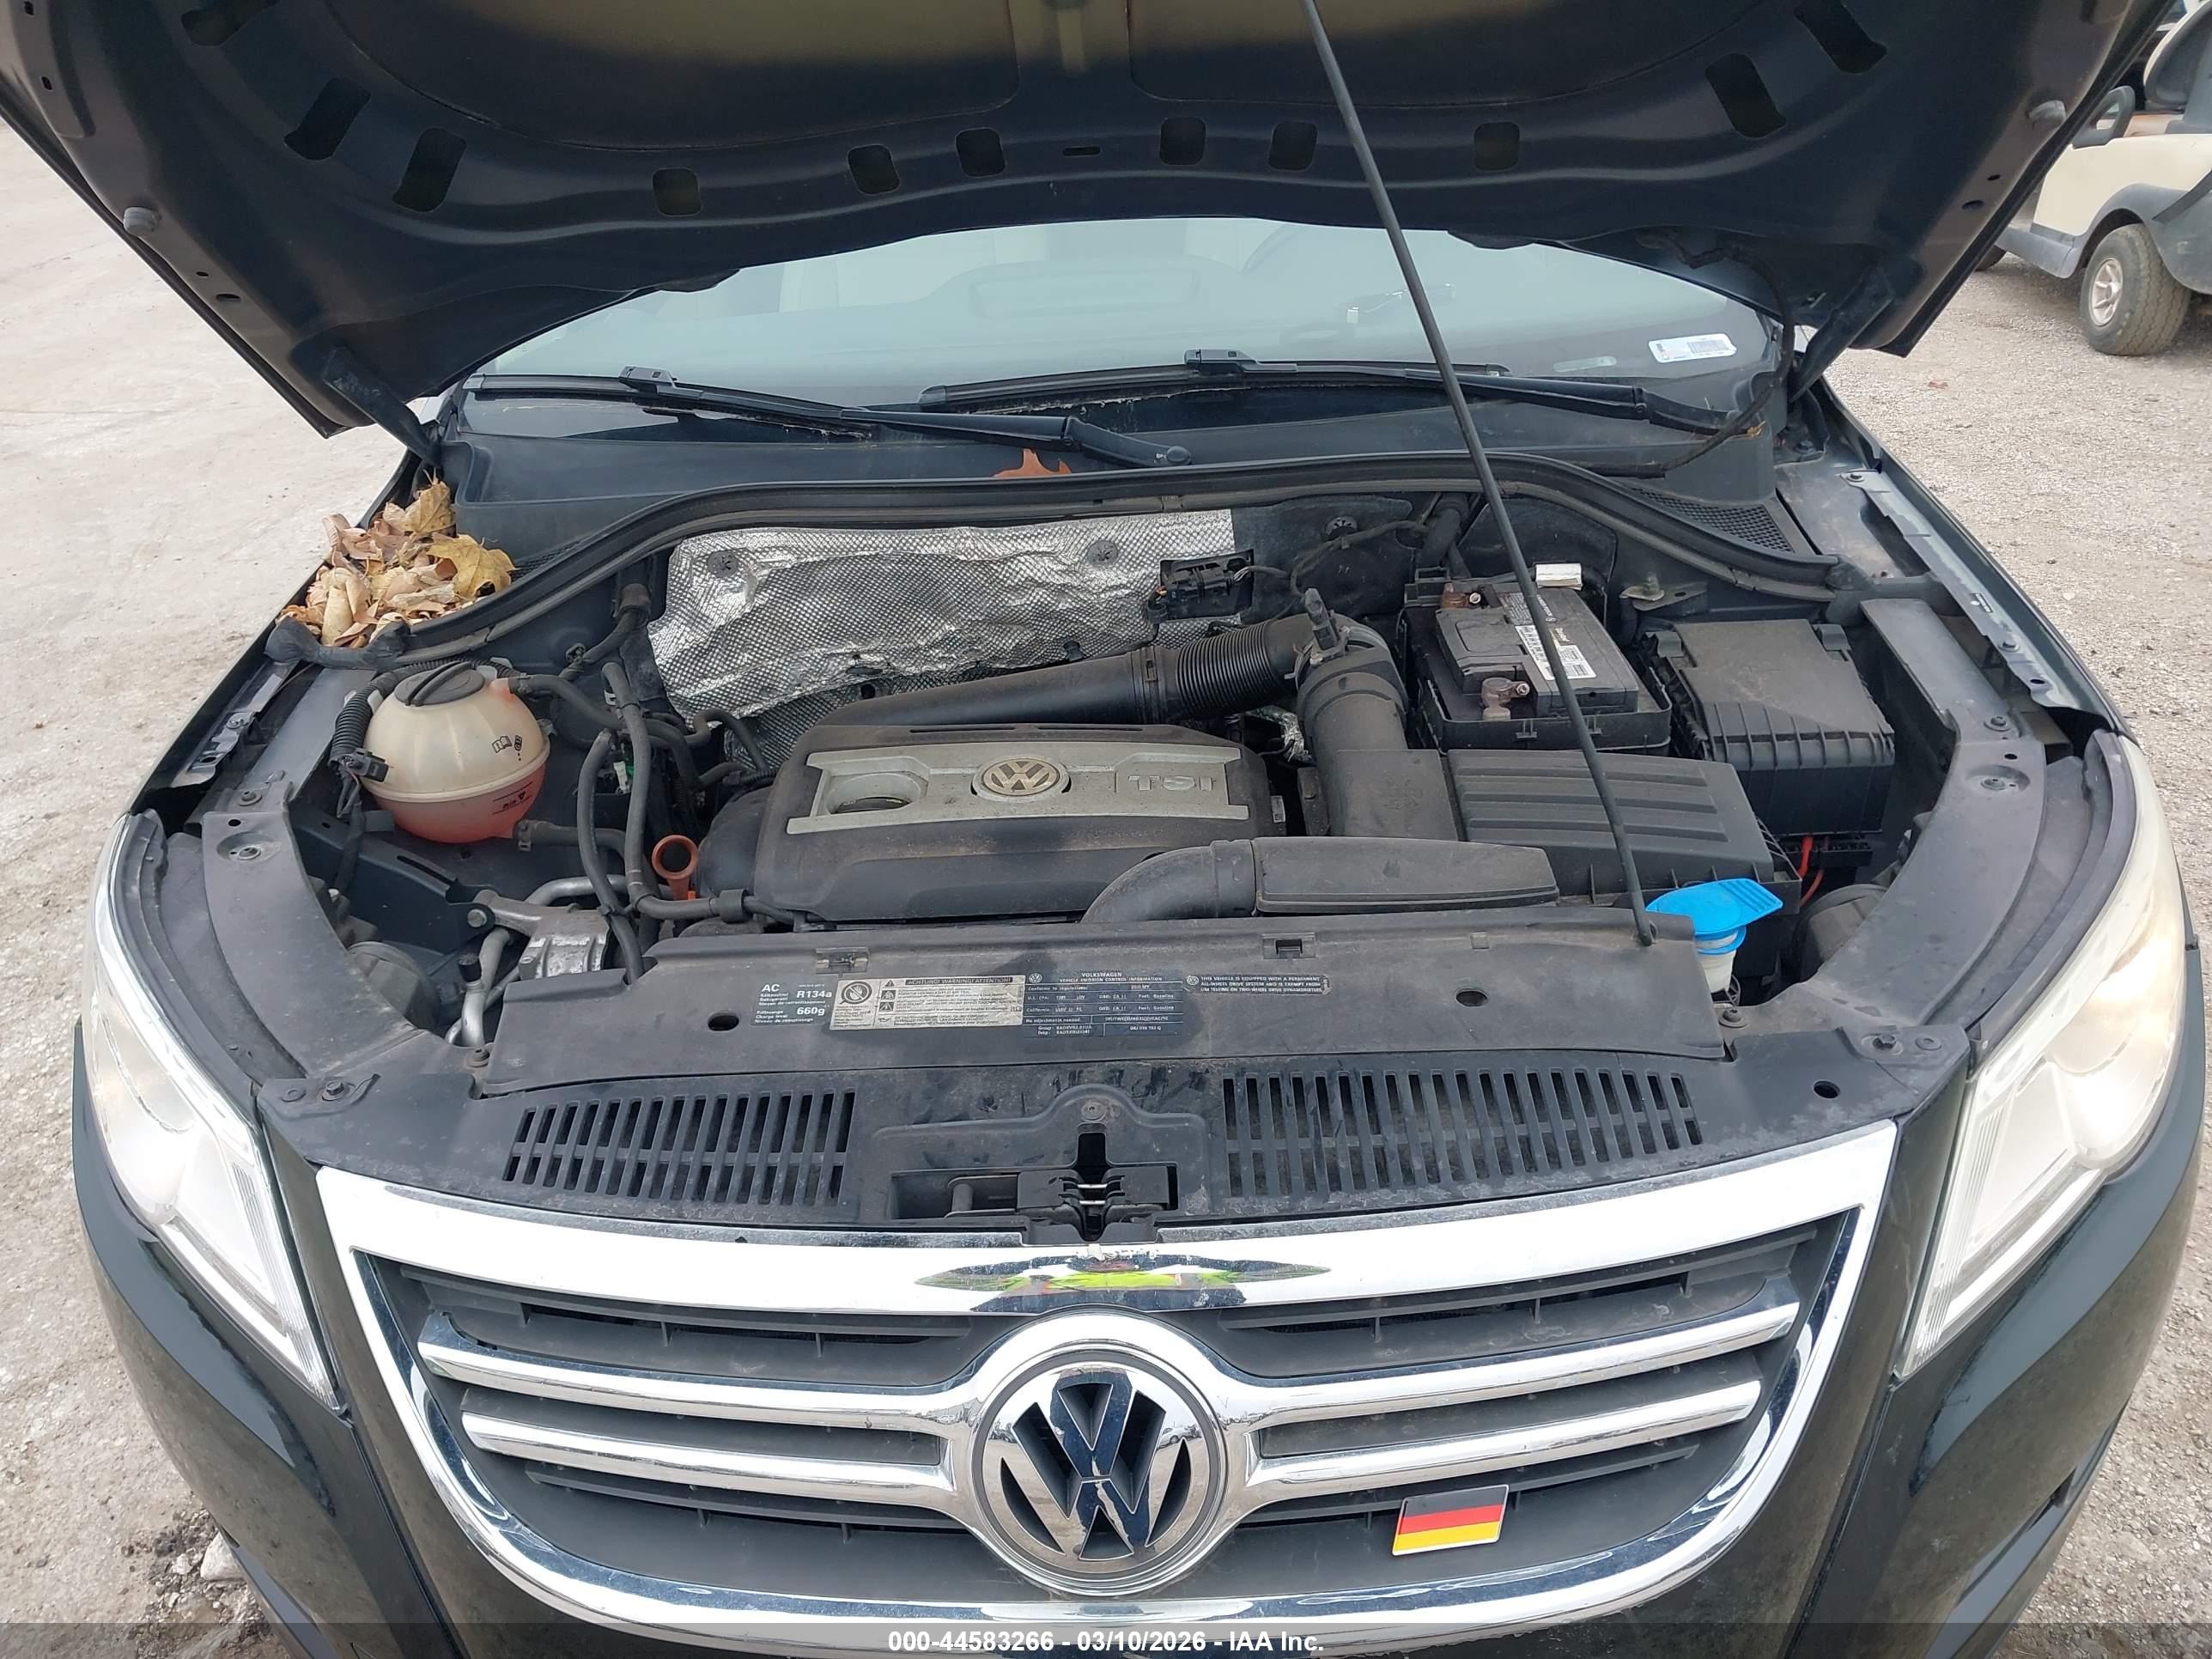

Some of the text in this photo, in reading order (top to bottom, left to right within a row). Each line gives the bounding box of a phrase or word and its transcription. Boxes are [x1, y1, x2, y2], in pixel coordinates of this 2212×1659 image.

[1127, 775, 1216, 791] TSI
[761, 983, 781, 993] AC
[796, 990, 832, 999] R134a
[797, 1006, 825, 1017] 660g
